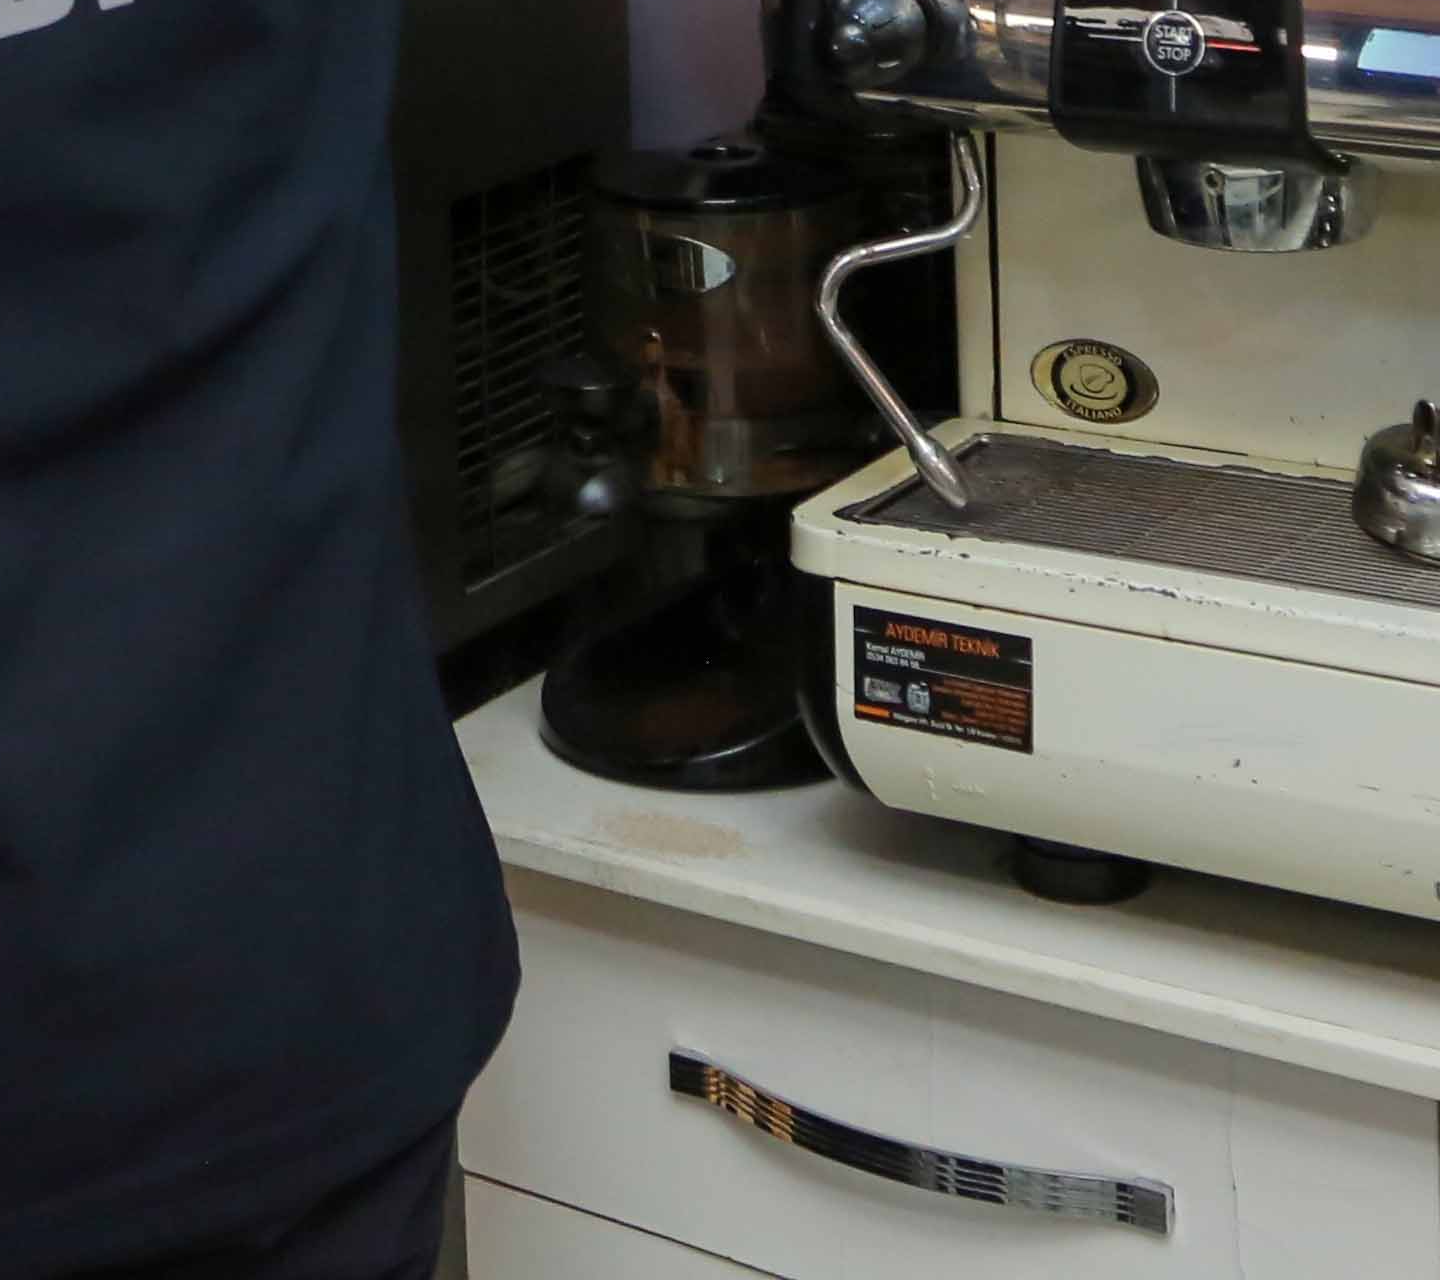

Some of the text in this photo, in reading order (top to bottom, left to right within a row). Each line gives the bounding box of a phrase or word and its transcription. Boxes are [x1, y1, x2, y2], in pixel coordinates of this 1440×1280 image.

[1154, 25, 1193, 40] START
[1157, 47, 1192, 61] STOP
[951, 633, 1001, 659] TEKNİK
